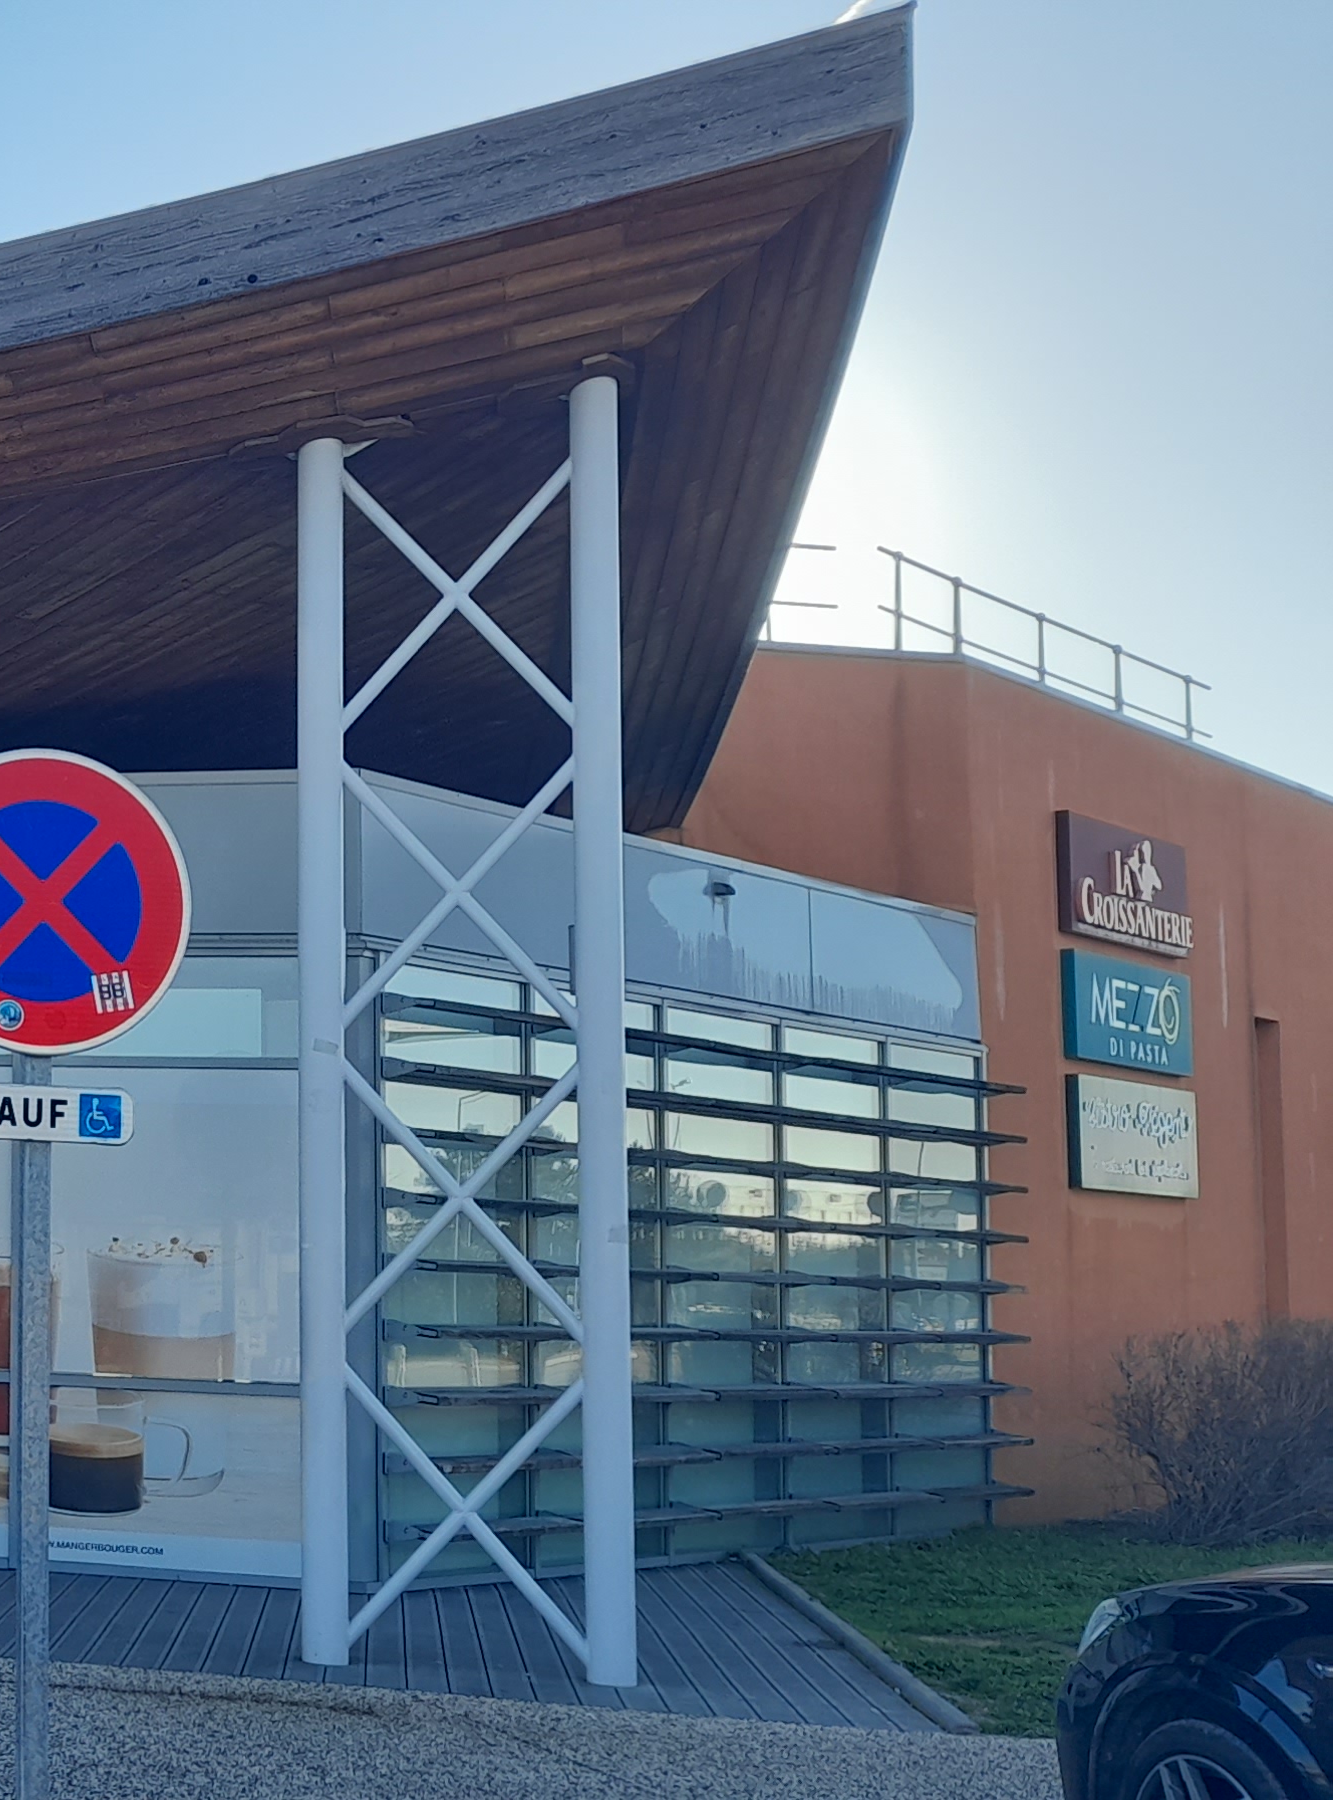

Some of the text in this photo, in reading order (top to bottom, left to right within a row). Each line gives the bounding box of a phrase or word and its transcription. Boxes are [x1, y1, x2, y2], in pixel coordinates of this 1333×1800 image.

[1080, 876, 1194, 949] CROISSANTERIE
[1109, 1036, 1169, 1066] DI PASTA
